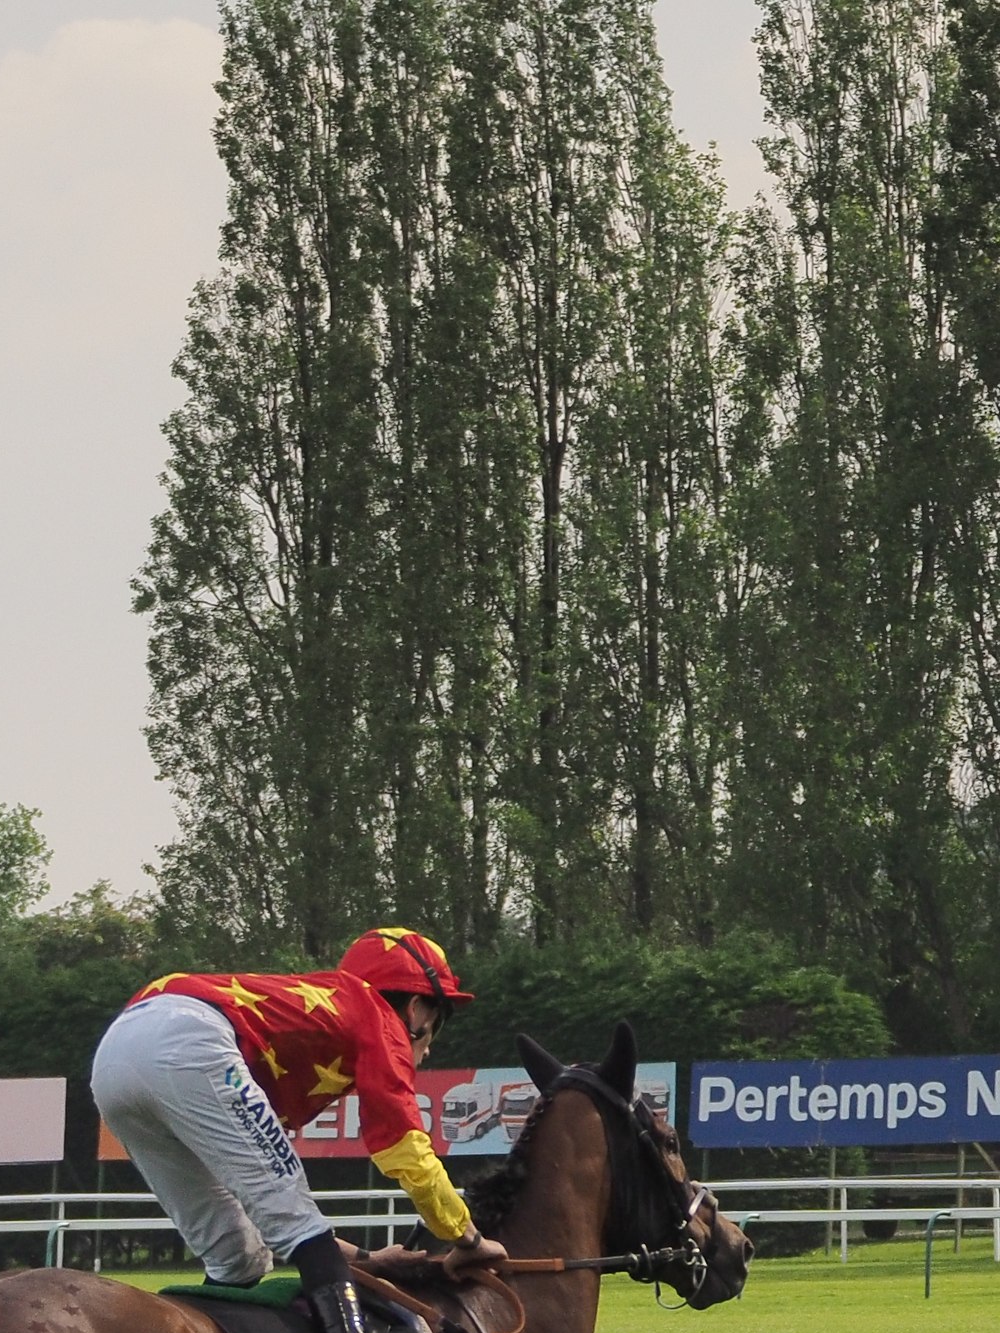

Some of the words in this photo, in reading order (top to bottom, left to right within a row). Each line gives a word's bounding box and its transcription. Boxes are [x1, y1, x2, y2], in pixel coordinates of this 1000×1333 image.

[231, 1100, 286, 1178] CONSTRUCTION
[240, 1084, 300, 1176] LAMBE
[698, 1075, 947, 1129] Pertemps
